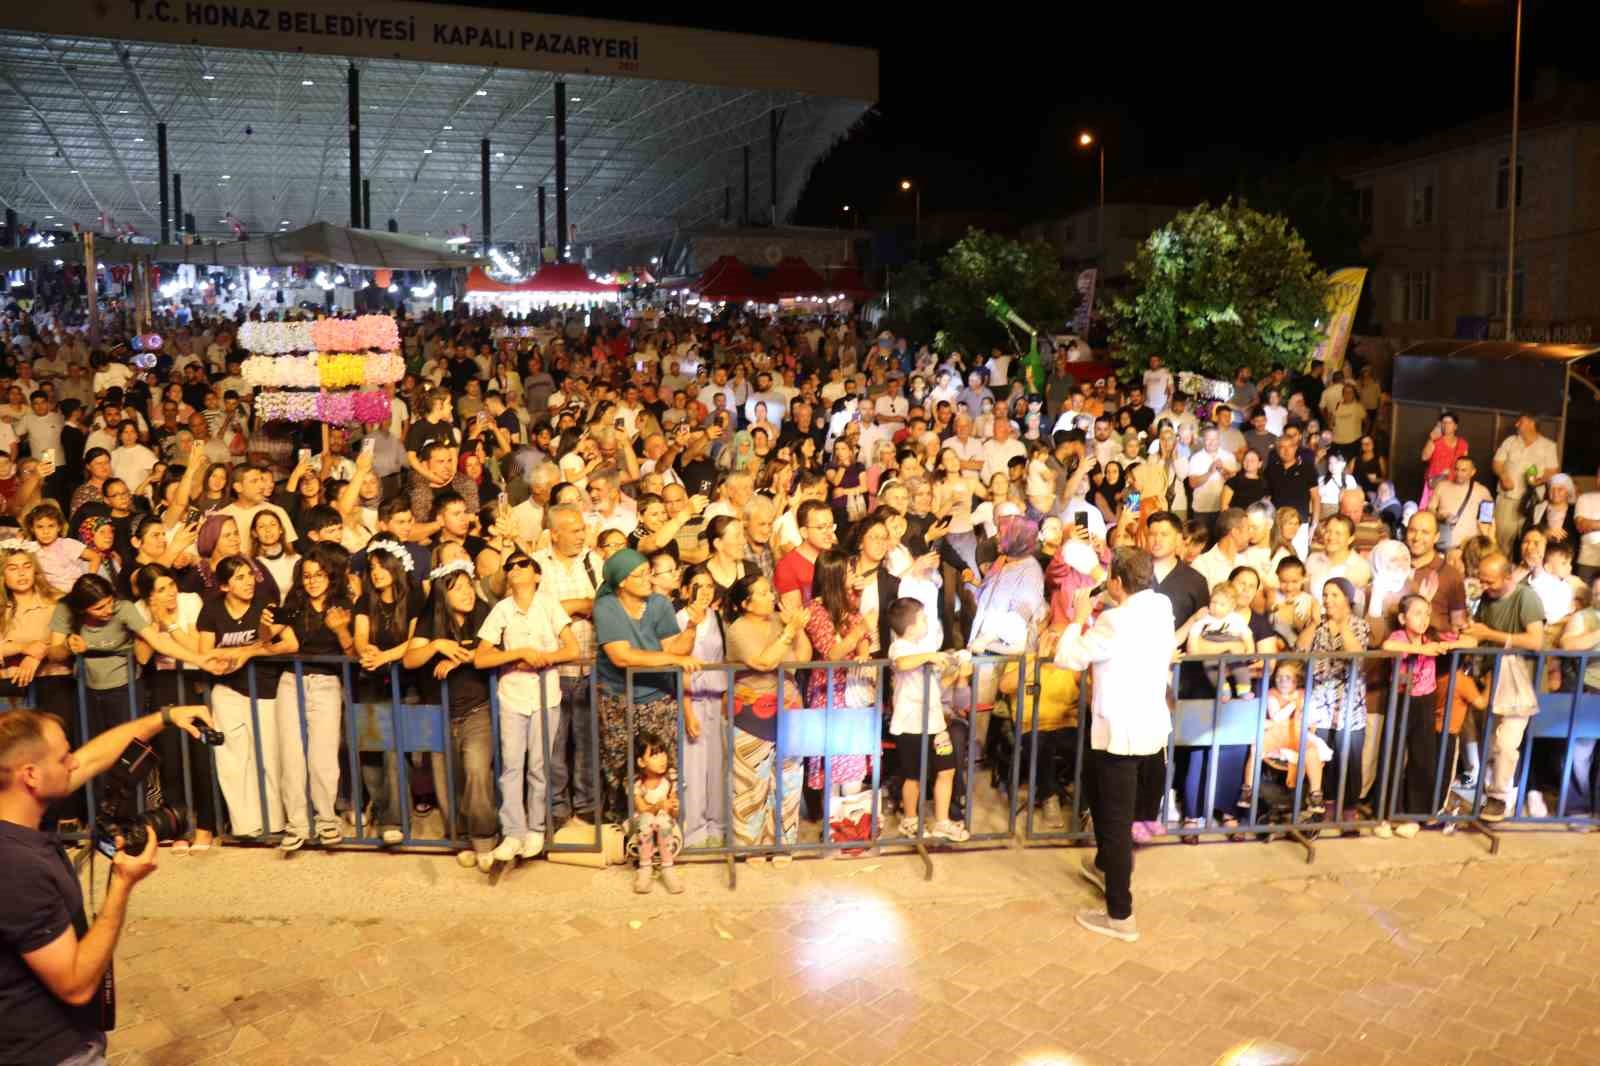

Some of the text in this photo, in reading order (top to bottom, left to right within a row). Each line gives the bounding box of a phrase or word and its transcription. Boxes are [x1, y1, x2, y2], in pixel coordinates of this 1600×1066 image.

[132, 0, 640, 60] T.C. HONAZ BELEDİYESİ KAPALI PAZARYERİ
[222, 629, 256, 646] NIKE
